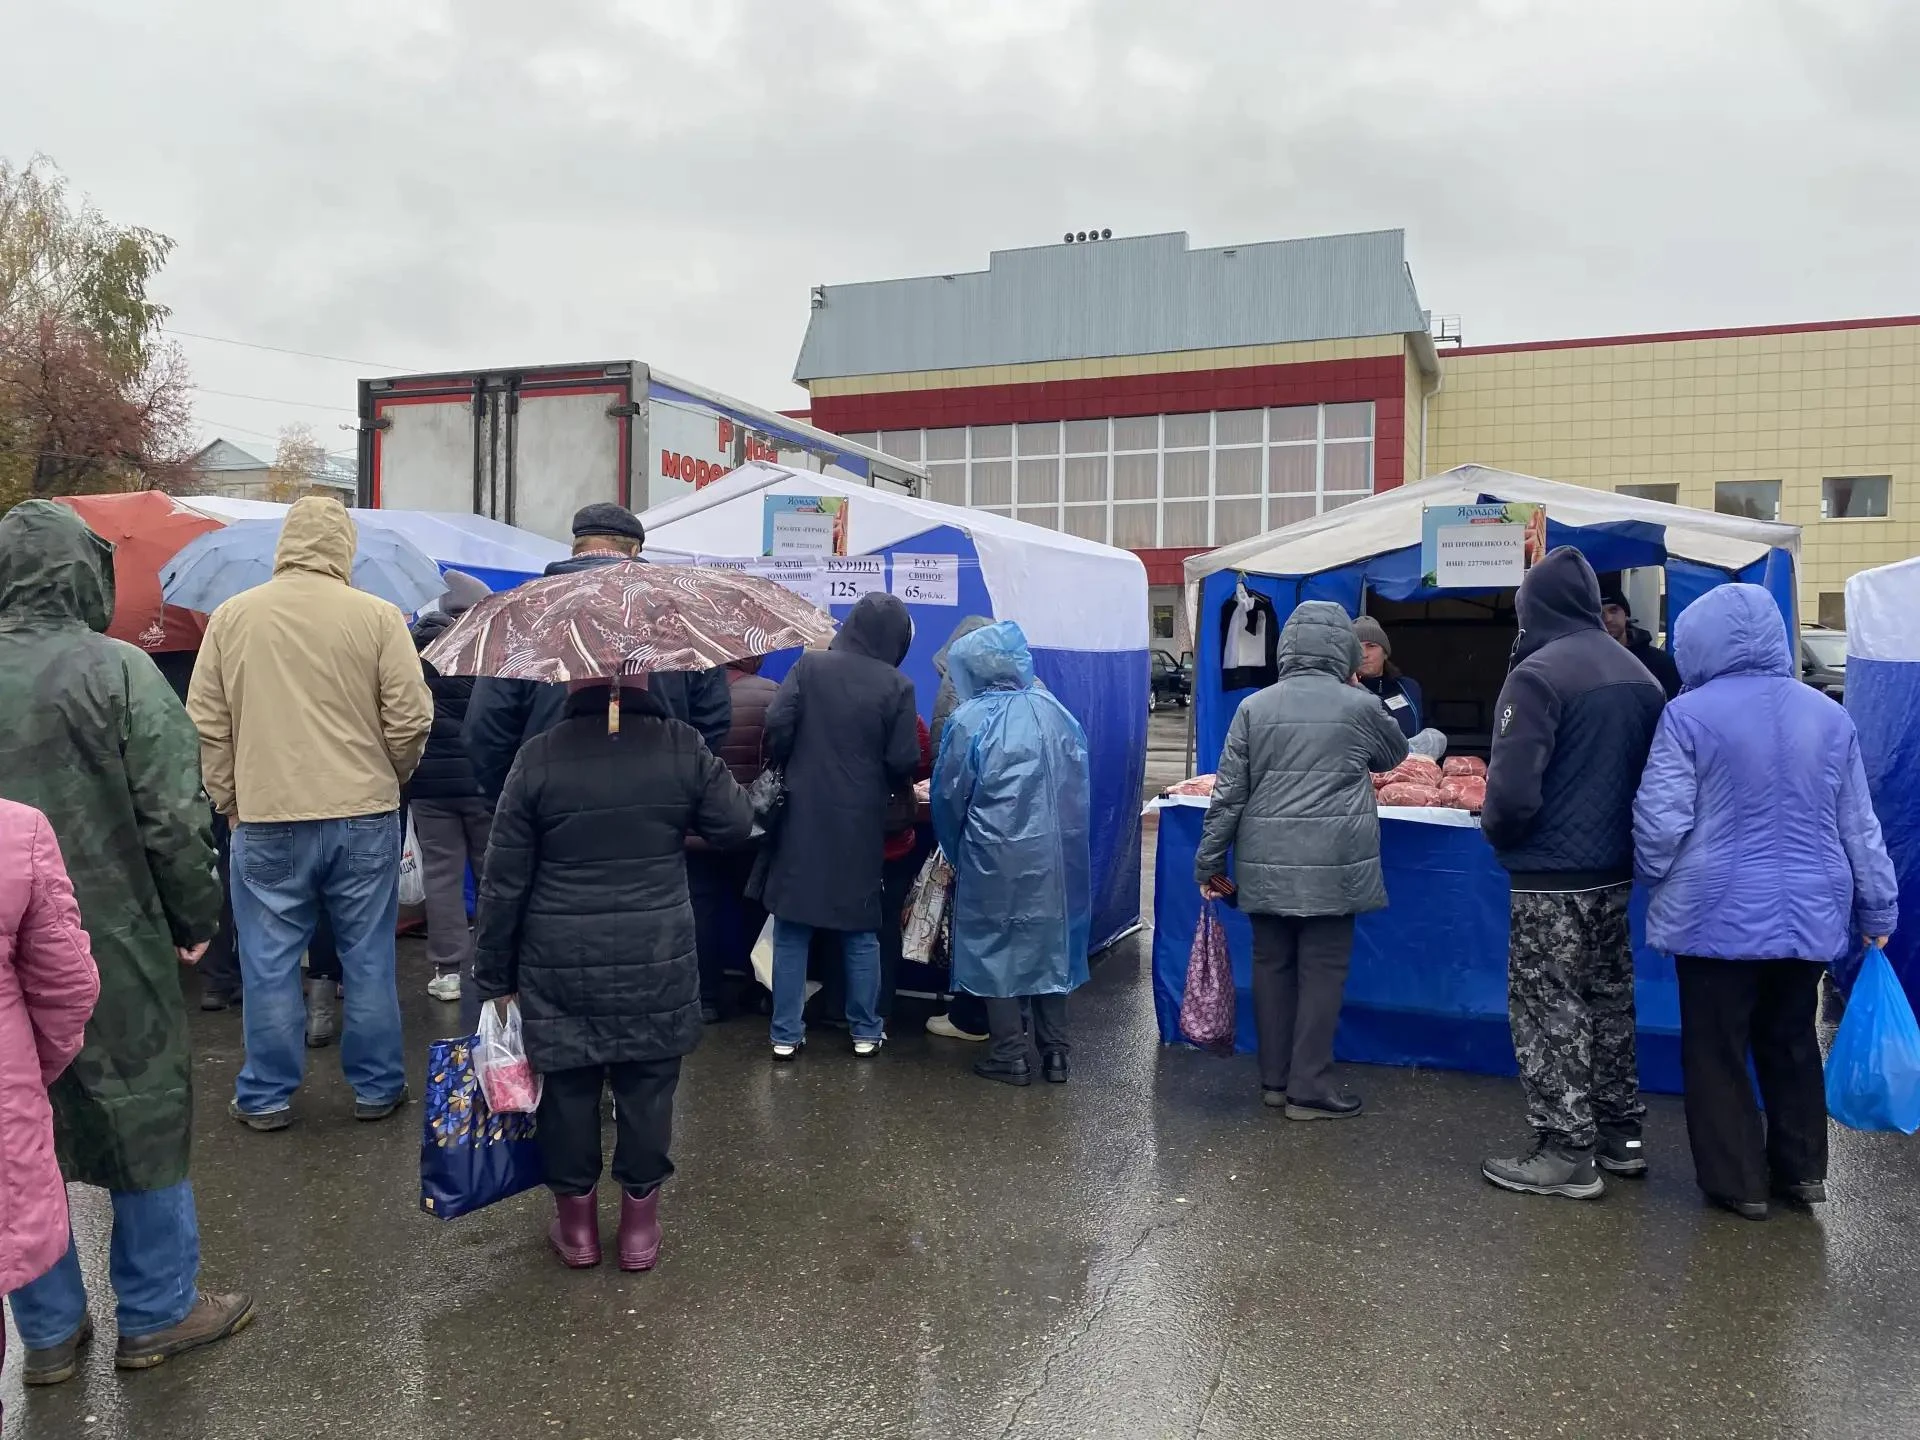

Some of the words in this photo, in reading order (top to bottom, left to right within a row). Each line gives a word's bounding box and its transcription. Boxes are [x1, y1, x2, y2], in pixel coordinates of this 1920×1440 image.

[775, 560, 803, 568] ФАРШ
[827, 560, 880, 573] КУРИЦА
[914, 558, 938, 567] РАГУ
[908, 571, 943, 581] СВИНОЕ
